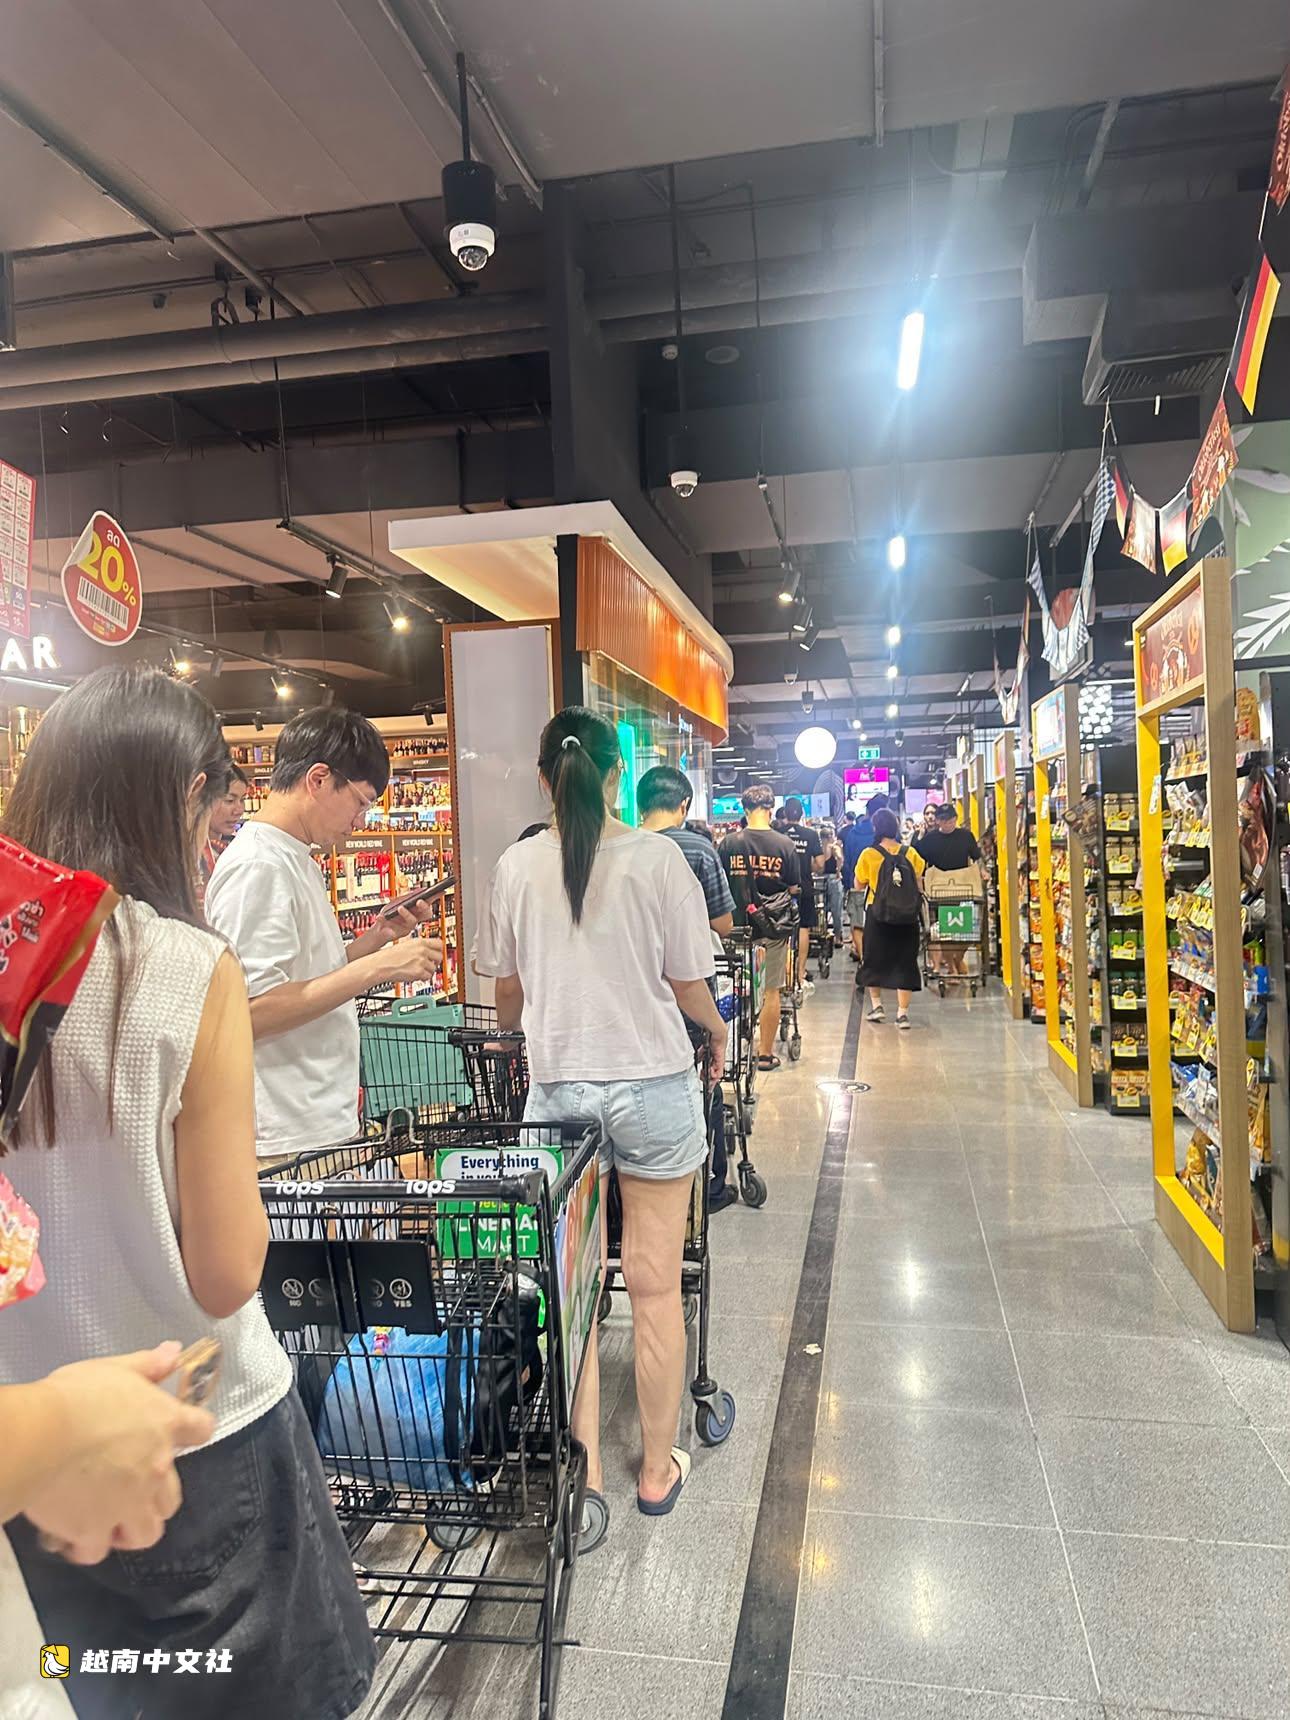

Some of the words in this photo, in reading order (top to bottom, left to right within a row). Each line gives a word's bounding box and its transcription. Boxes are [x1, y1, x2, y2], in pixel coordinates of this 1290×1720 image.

[77, 531, 136, 606] 20%
[460, 1154, 539, 1171] Everything
[275, 1180, 325, 1199] Tops
[405, 1179, 457, 1198] Tops
[501, 1213, 540, 1232] MA
